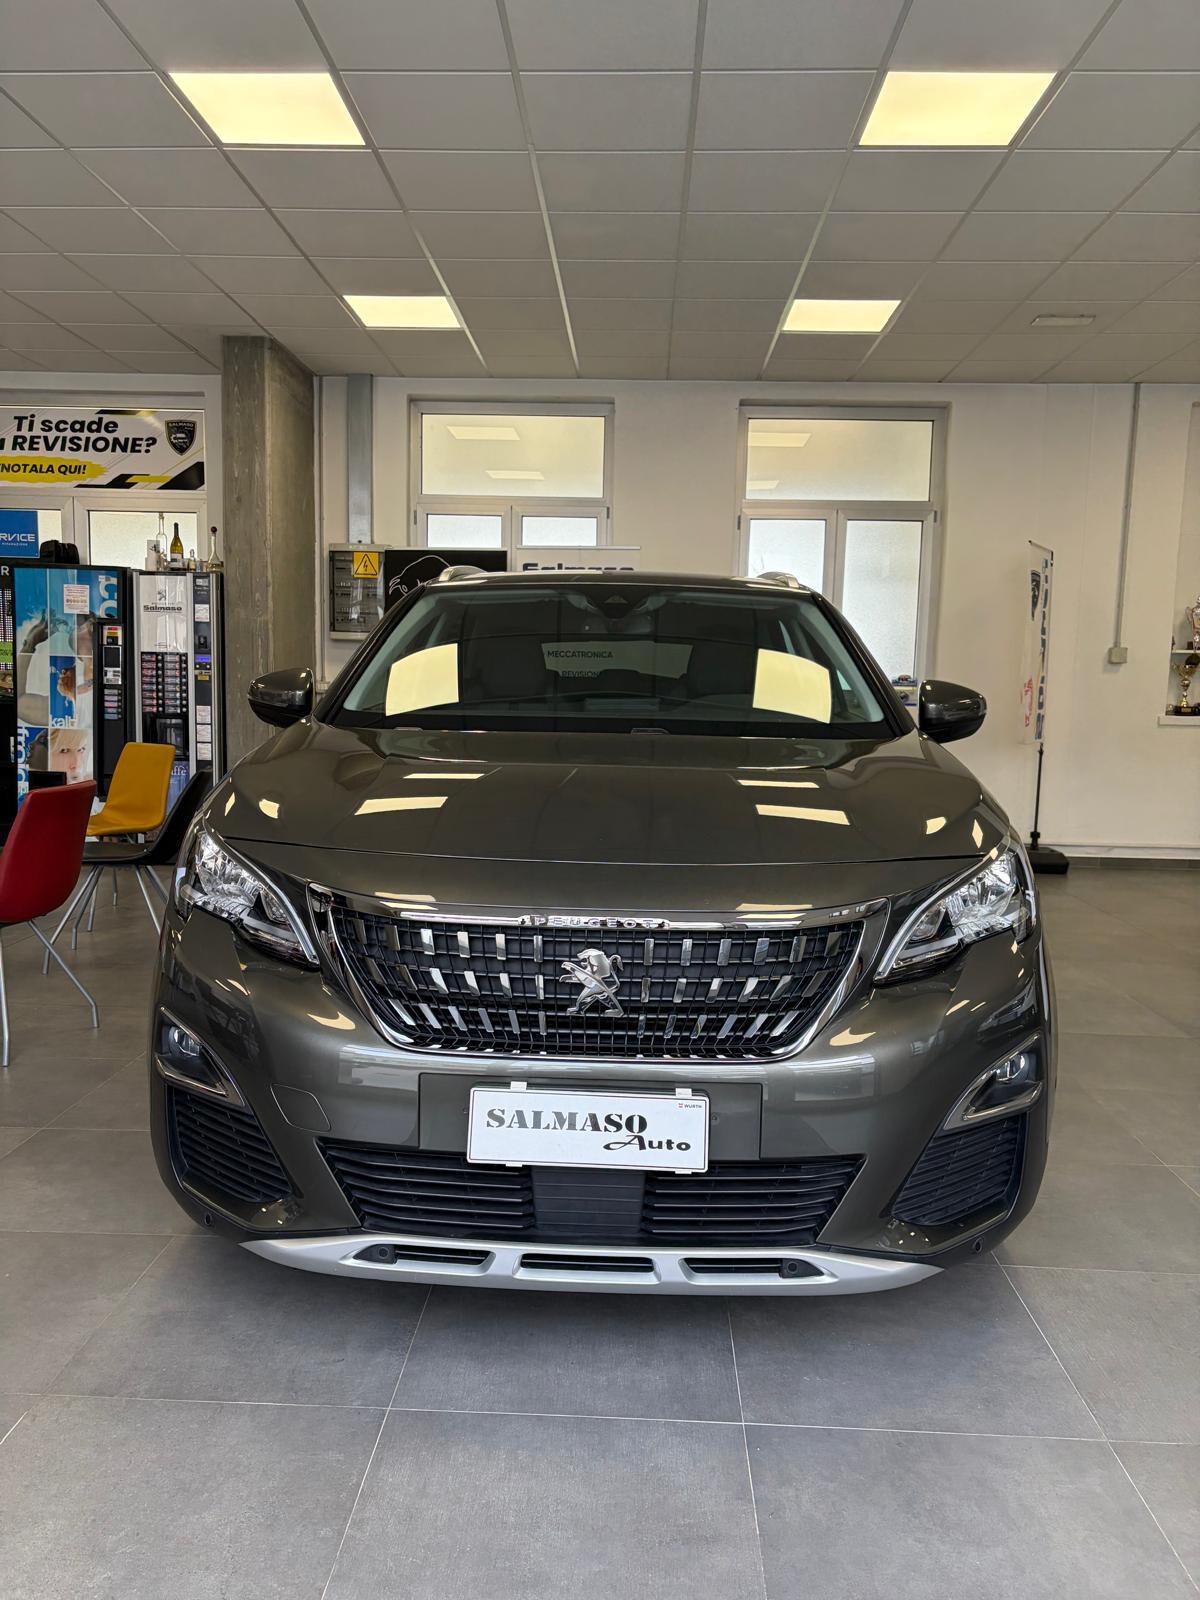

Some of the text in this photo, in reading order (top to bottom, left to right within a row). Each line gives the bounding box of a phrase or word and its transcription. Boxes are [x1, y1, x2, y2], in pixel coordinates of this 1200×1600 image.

[14, 414, 119, 433] Ti scade
[12, 435, 157, 453] REVISIONE?
[0, 463, 87, 475] NOTALA QUI!
[486, 1108, 648, 1134] SALMASO
[603, 1134, 691, 1152] Auto
